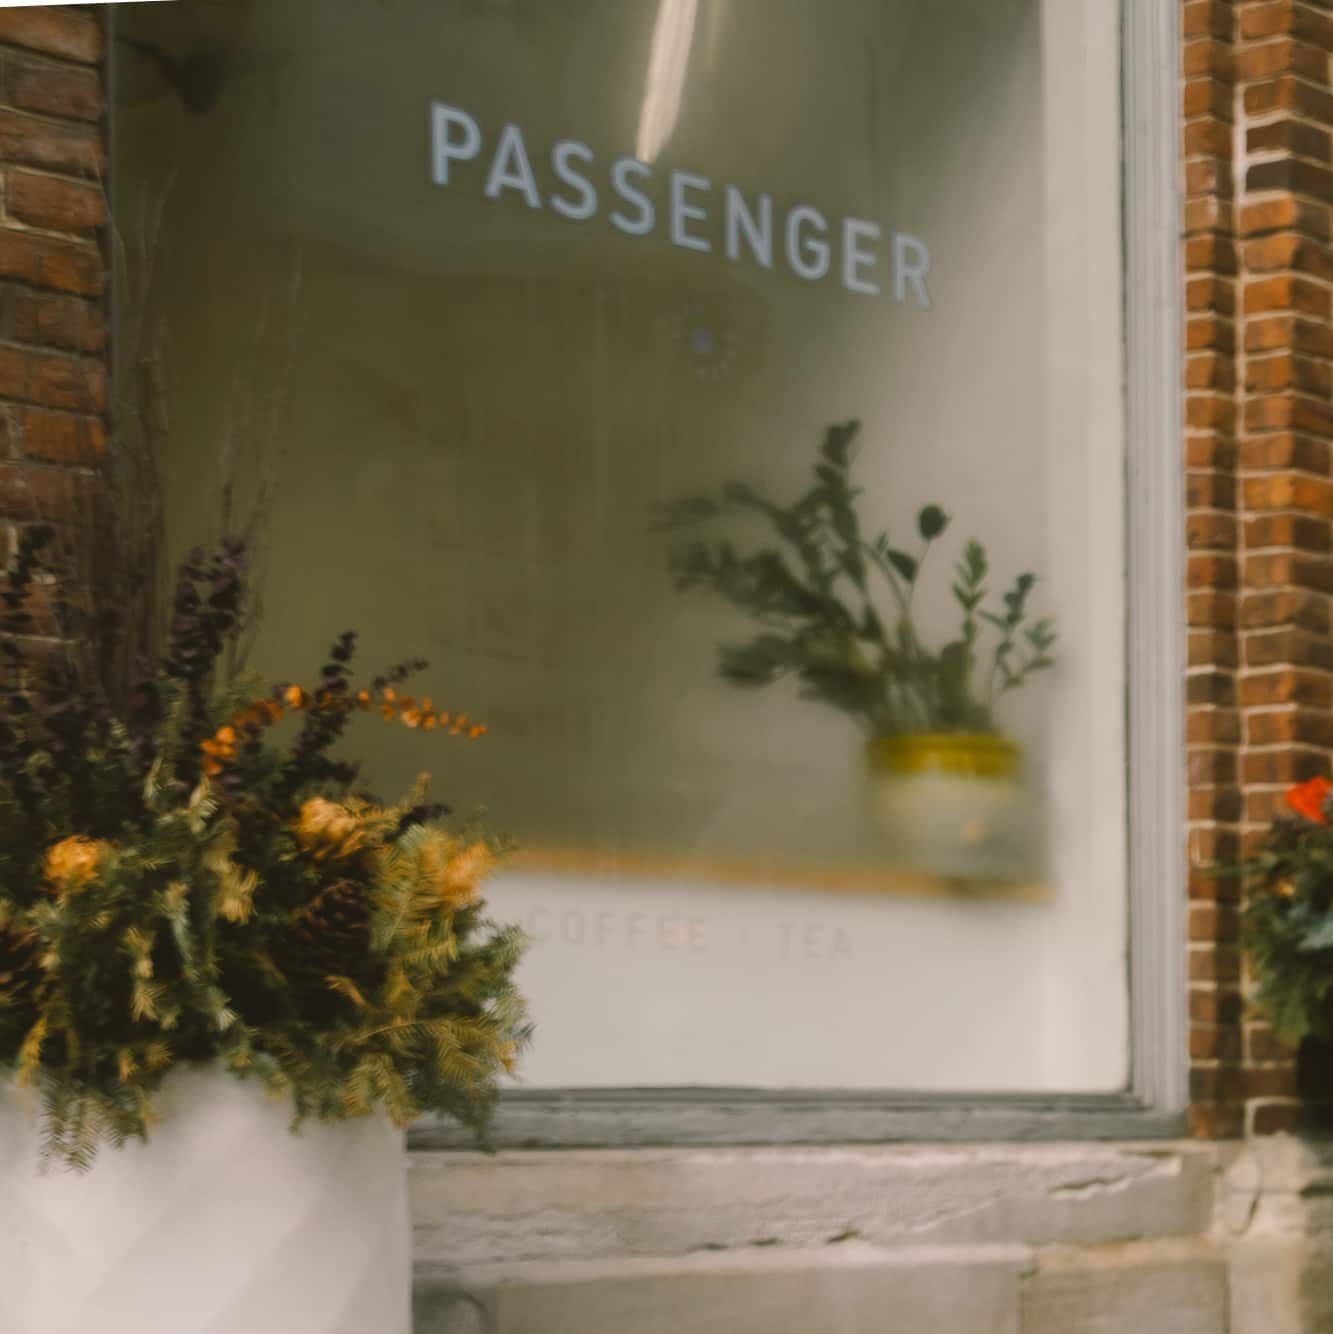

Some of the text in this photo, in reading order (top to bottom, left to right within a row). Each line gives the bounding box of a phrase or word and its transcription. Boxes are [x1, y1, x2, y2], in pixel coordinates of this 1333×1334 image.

[428, 101, 934, 310] PASSENGER
[528, 905, 856, 961] COFFEE TEA
